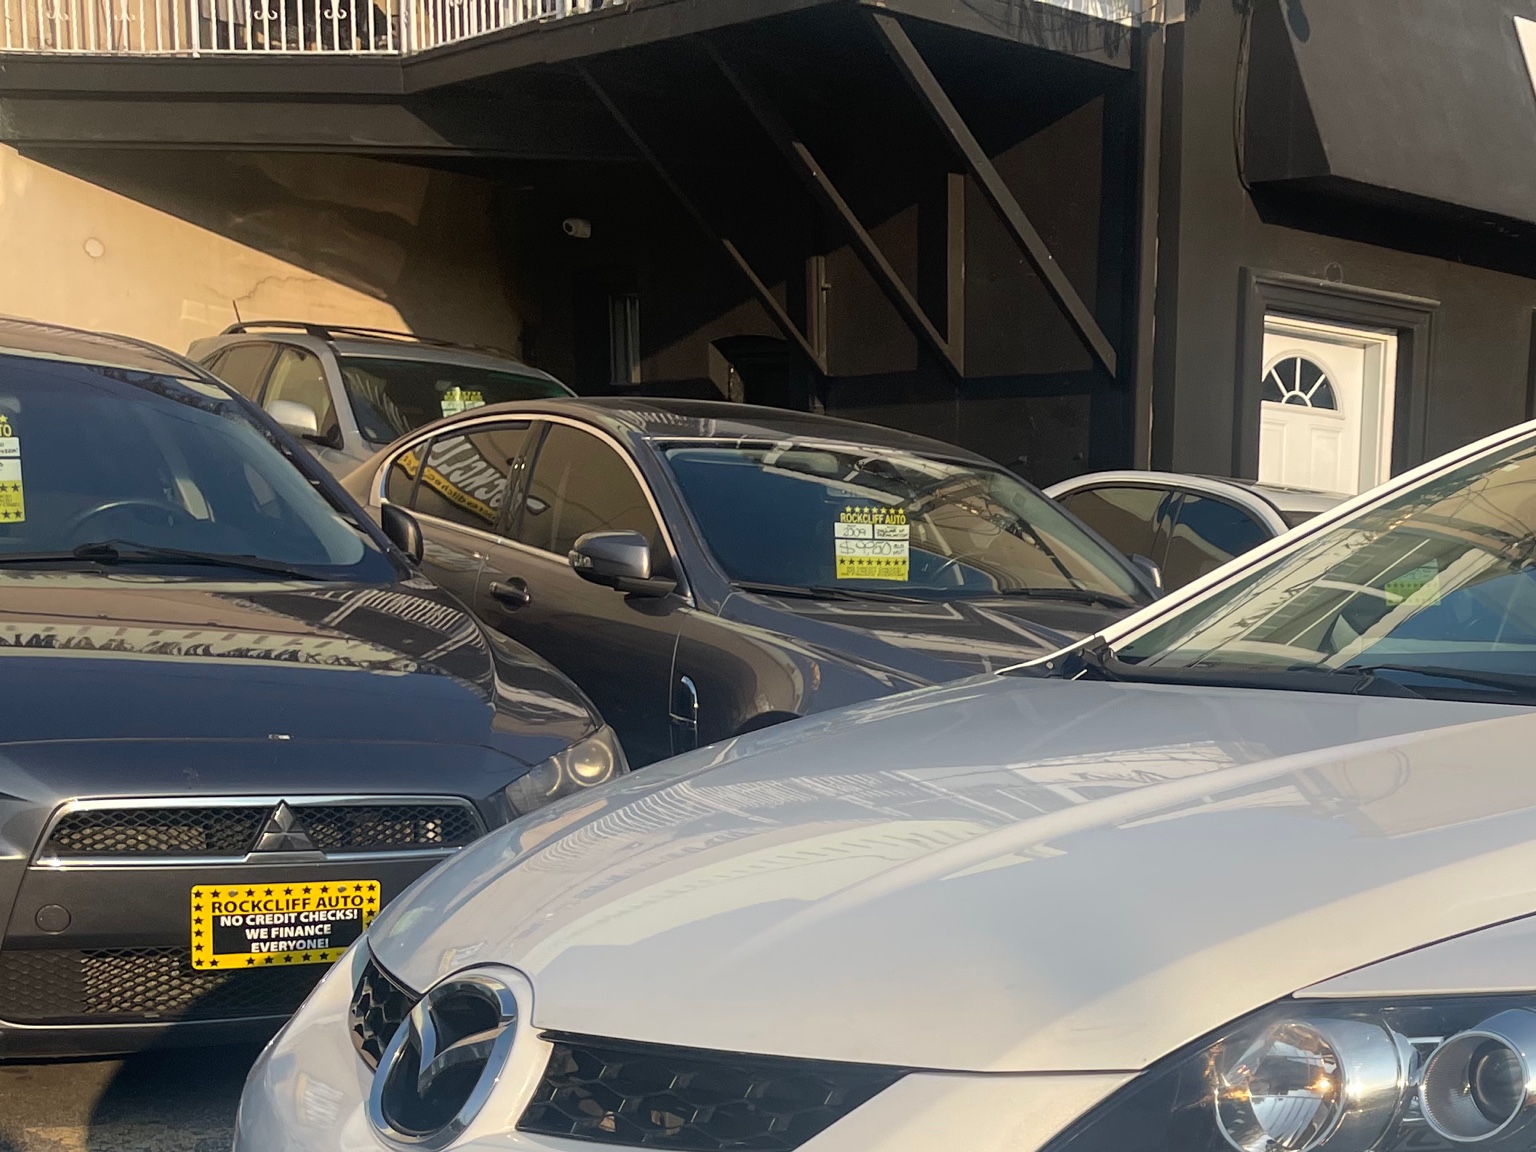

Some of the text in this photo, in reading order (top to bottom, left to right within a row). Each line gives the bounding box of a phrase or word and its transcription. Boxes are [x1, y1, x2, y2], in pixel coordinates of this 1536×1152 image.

[840, 512, 907, 525] ROCKCLIFF AUTO
[211, 894, 365, 914] ROCKCLIFF AUTO
[219, 908, 358, 928] NO CREDIT CHECKS!
[244, 923, 332, 940] WE FINANCE
[250, 938, 330, 954] EVERYONE!
